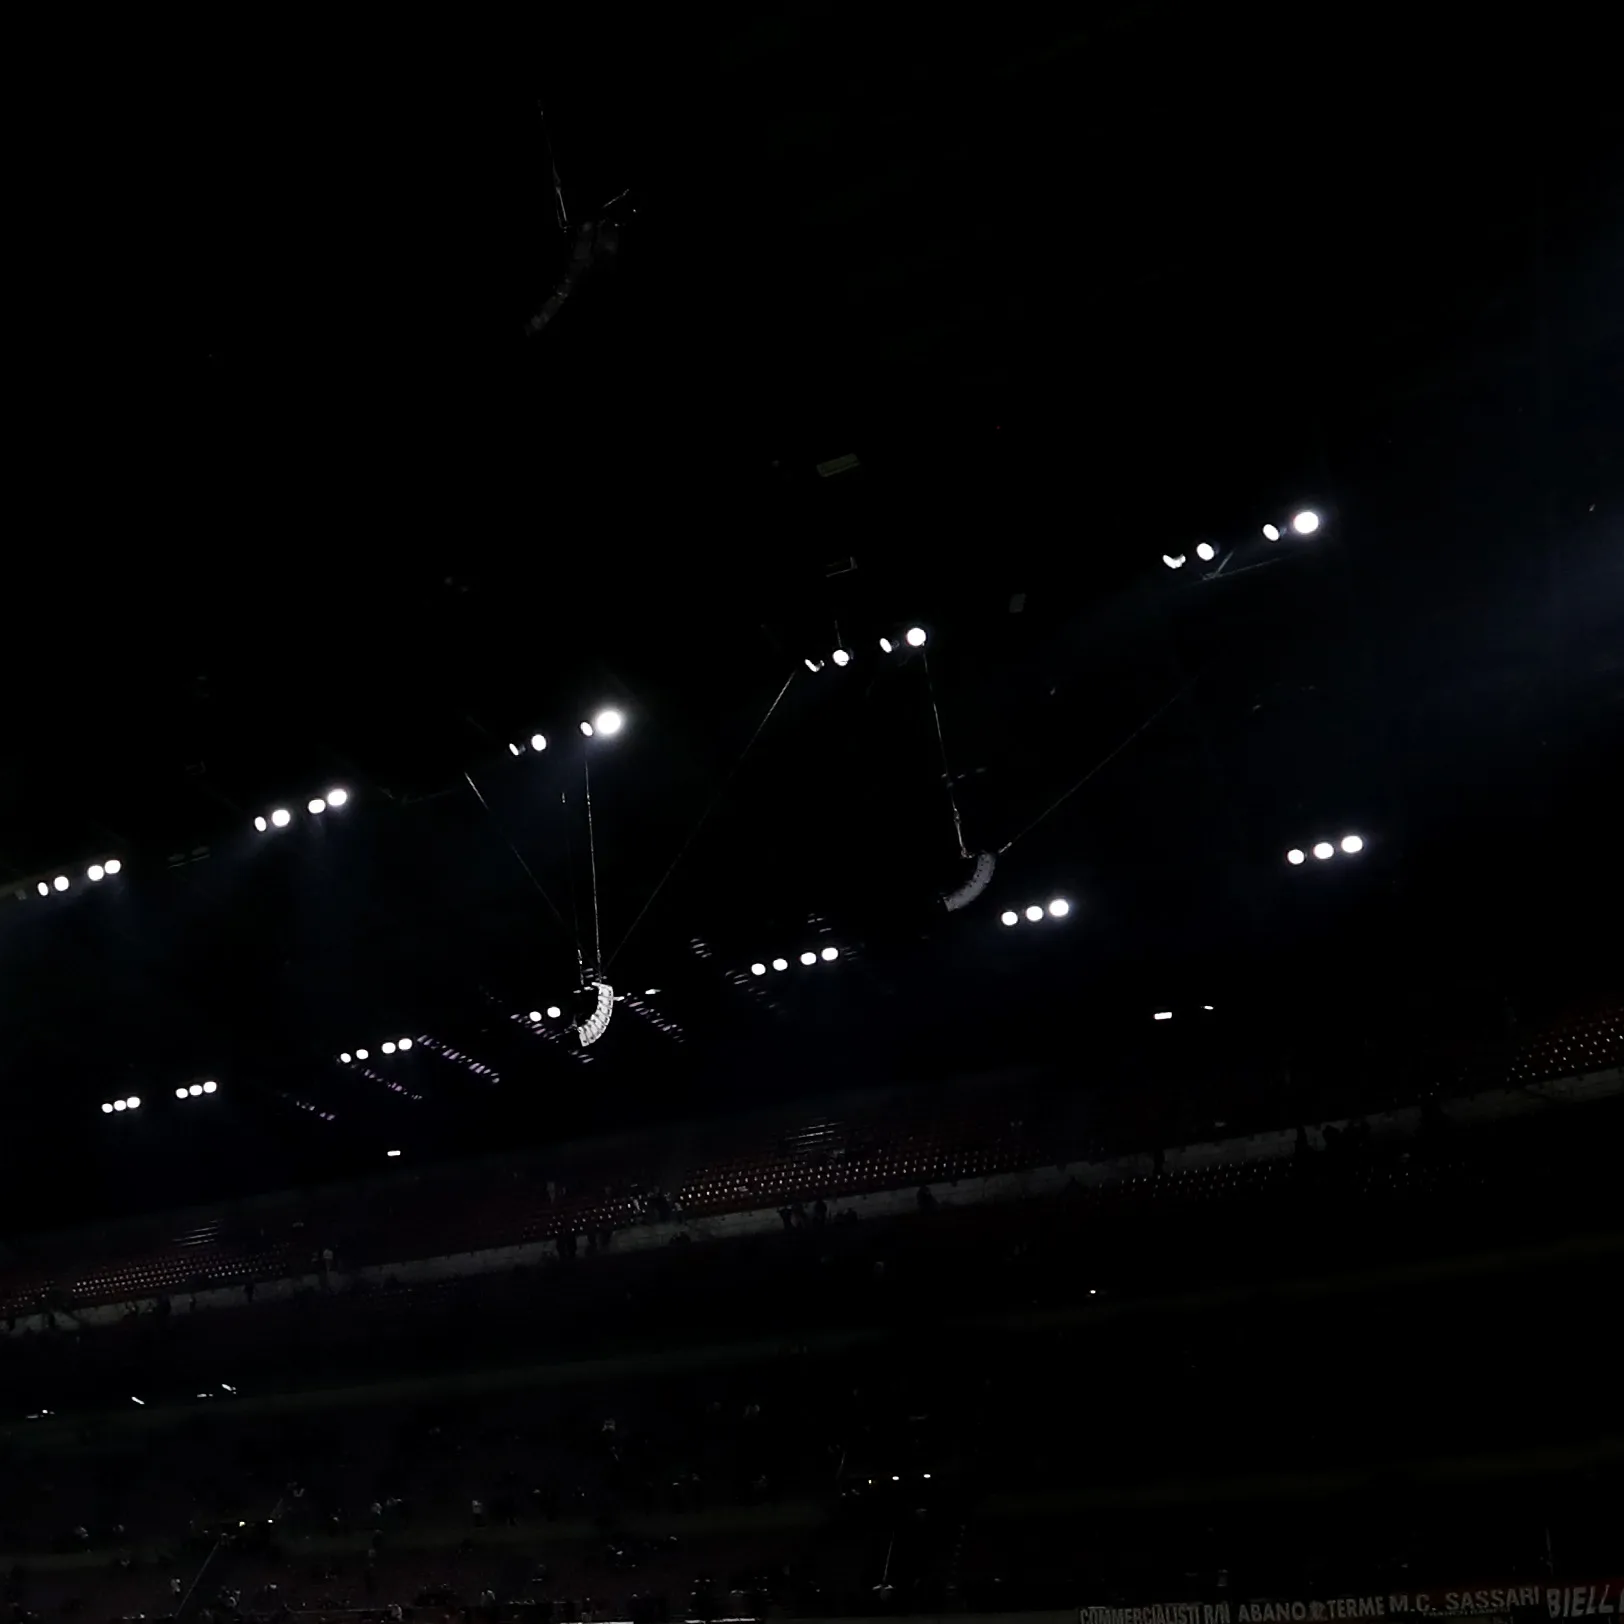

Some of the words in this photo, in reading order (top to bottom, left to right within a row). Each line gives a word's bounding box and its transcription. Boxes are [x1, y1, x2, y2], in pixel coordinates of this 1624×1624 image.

[1238, 1602, 1307, 1623] ABANO
[1327, 1596, 1385, 1620] TERME
[1444, 1586, 1540, 1611] SASSARI
[1546, 1584, 1624, 1619] BIELL
